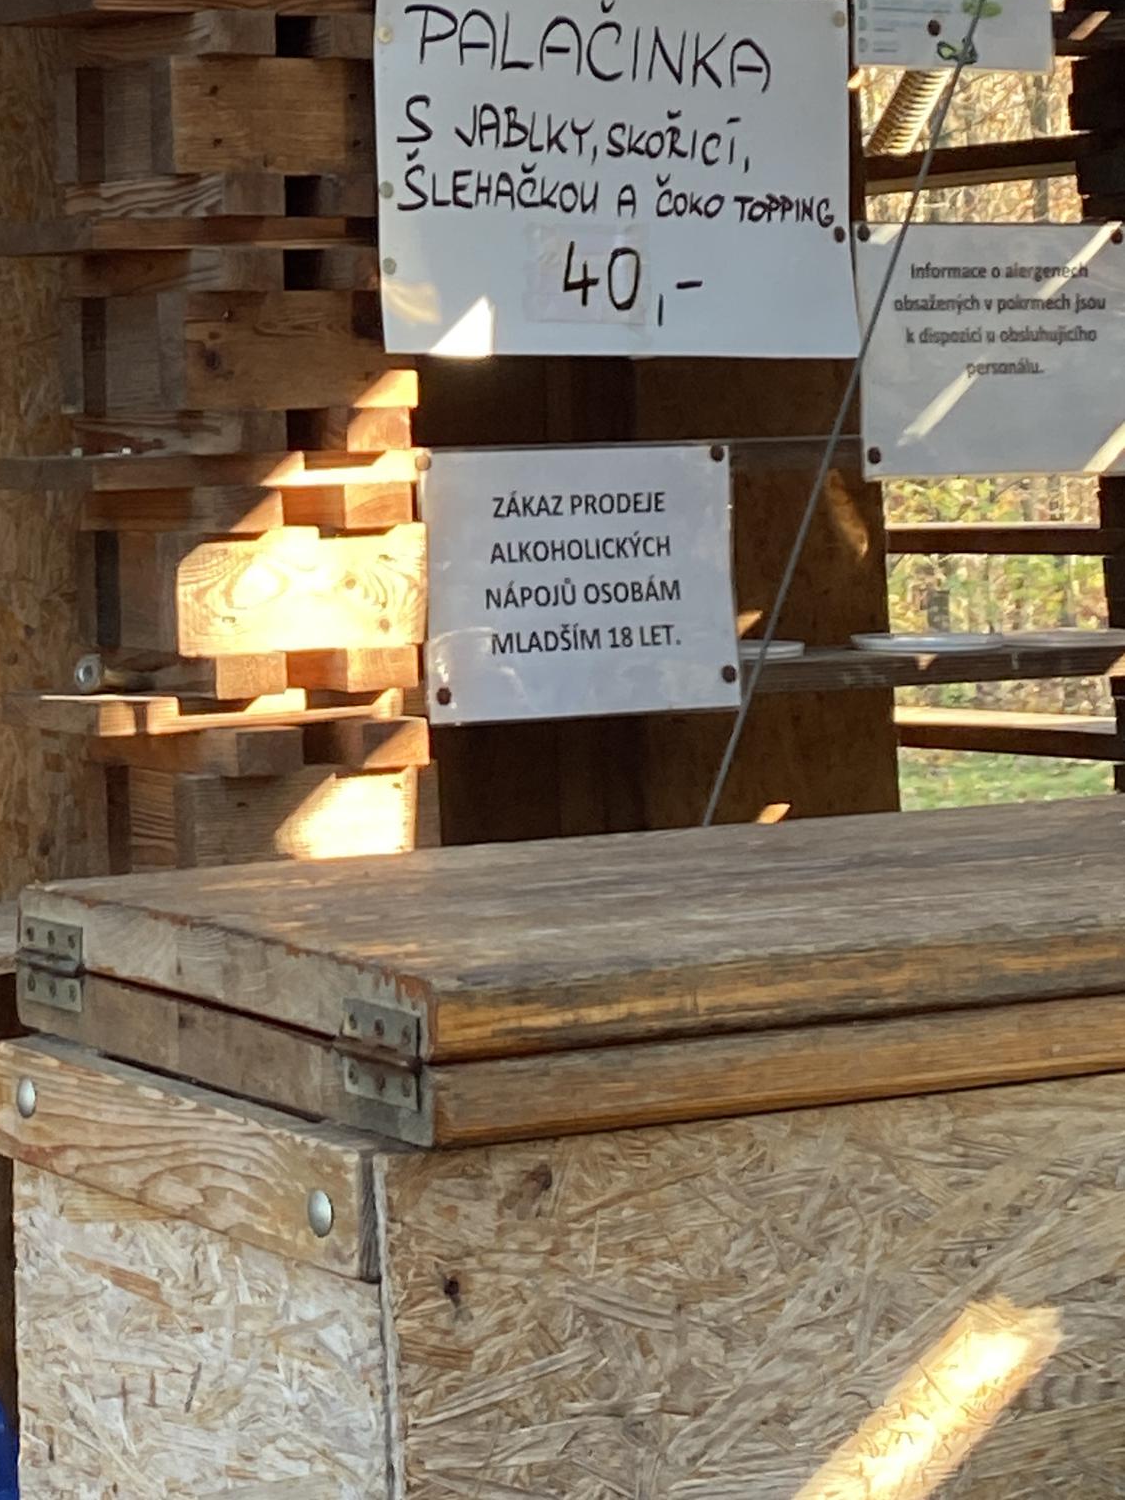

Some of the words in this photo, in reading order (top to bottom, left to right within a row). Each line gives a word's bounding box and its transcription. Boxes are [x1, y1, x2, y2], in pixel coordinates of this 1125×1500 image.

[396, 95, 433, 144] S
[396, 148, 599, 213] ŠLEHAČKOU
[617, 184, 637, 218] A
[655, 174, 725, 219] ČOKO
[562, 241, 703, 326] 40,-
[910, 262, 986, 279] Informace
[991, 266, 1000, 278] o
[1005, 262, 1088, 282] alergenech
[894, 294, 980, 315] obsažených
[983, 300, 992, 310] v
[997, 293, 1071, 314] pokrmech
[1074, 294, 1105, 314] jsou
[906, 327, 915, 343] k
[919, 326, 982, 347] dispozici
[986, 332, 995, 342] u
[1000, 325, 1097, 345] obsluhujícího
[966, 358, 1044, 378] personálu.
[492, 491, 563, 518] ZÁKAZ
[570, 492, 666, 516] PRODEJE
[490, 531, 670, 564] ALKOHOLICKÝCH
[485, 578, 575, 609] NÁPOJŮ
[583, 575, 681, 605] OSOBÁM
[492, 623, 601, 655] MLADŠÍM
[608, 626, 632, 648] 18
[640, 625, 681, 647] LET.
